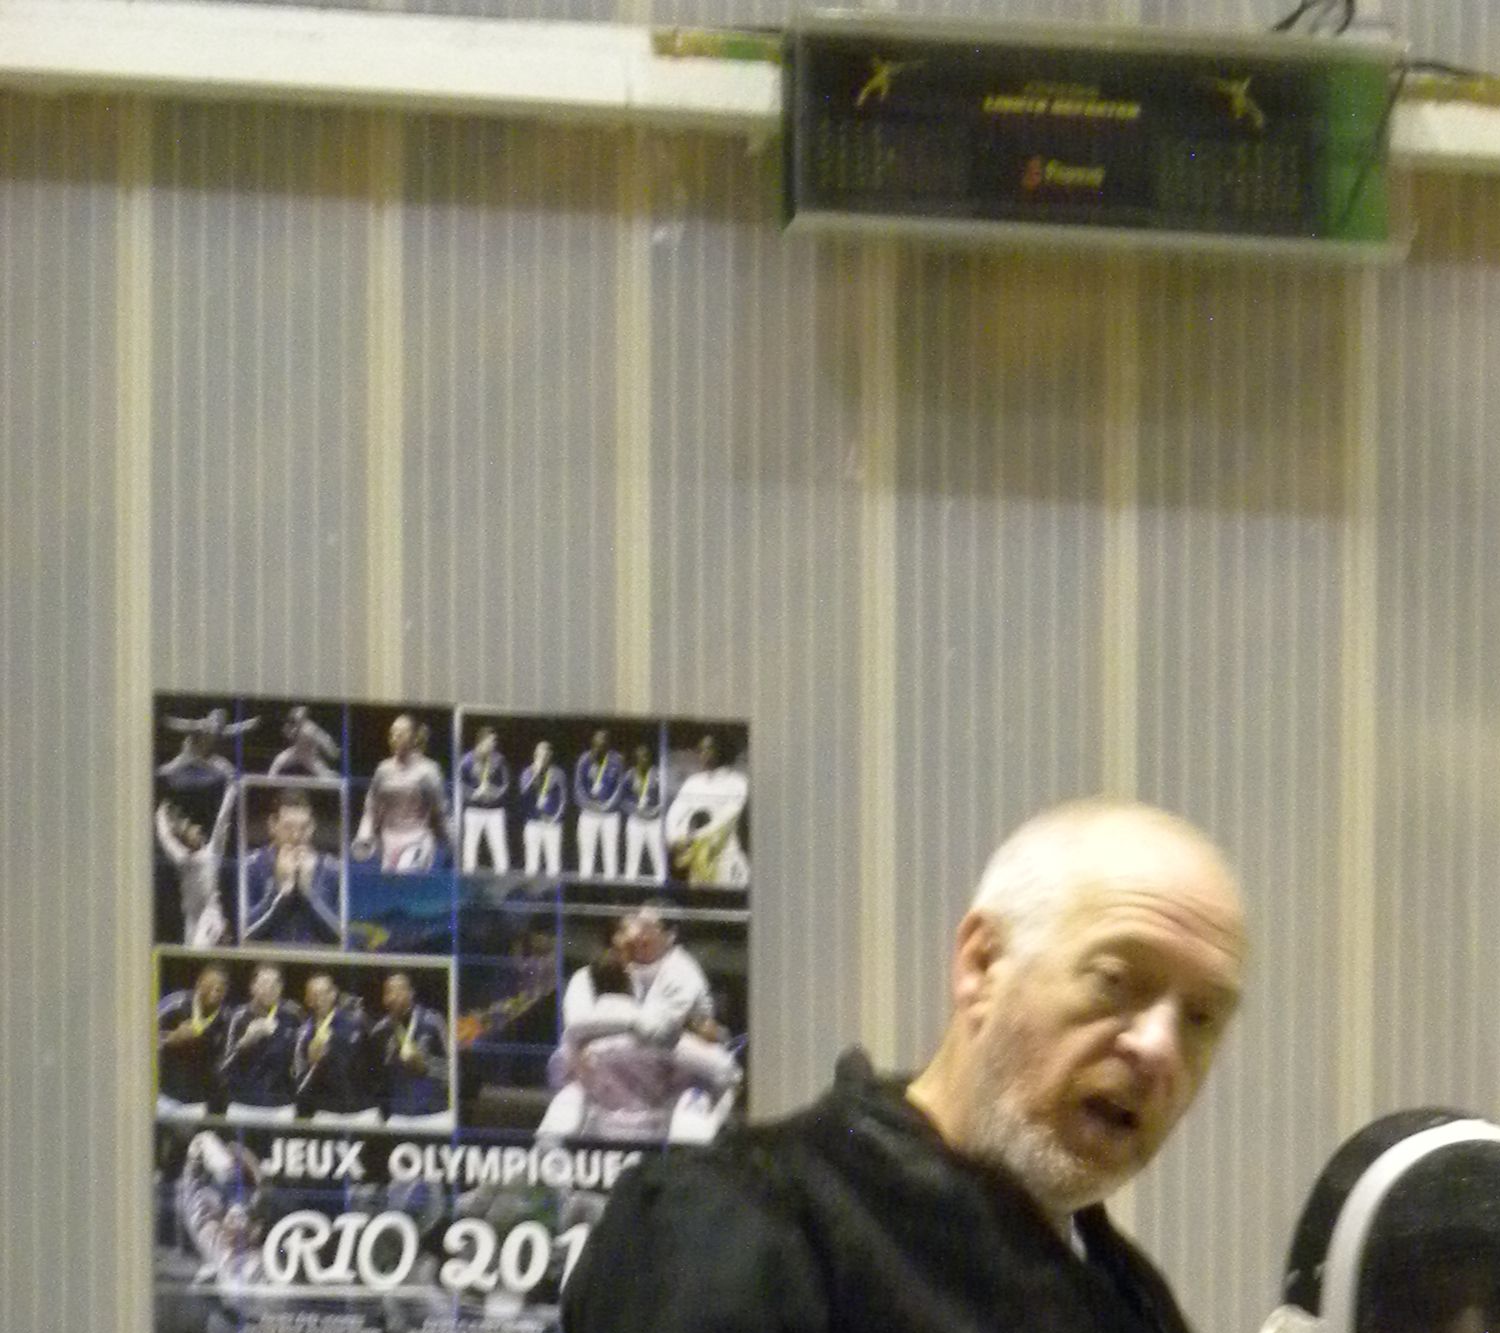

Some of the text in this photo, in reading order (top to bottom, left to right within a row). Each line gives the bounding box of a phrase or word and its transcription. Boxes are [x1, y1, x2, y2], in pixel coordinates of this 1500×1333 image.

[260, 1137, 364, 1180] JEUX
[262, 1210, 591, 1296] RIO 201
